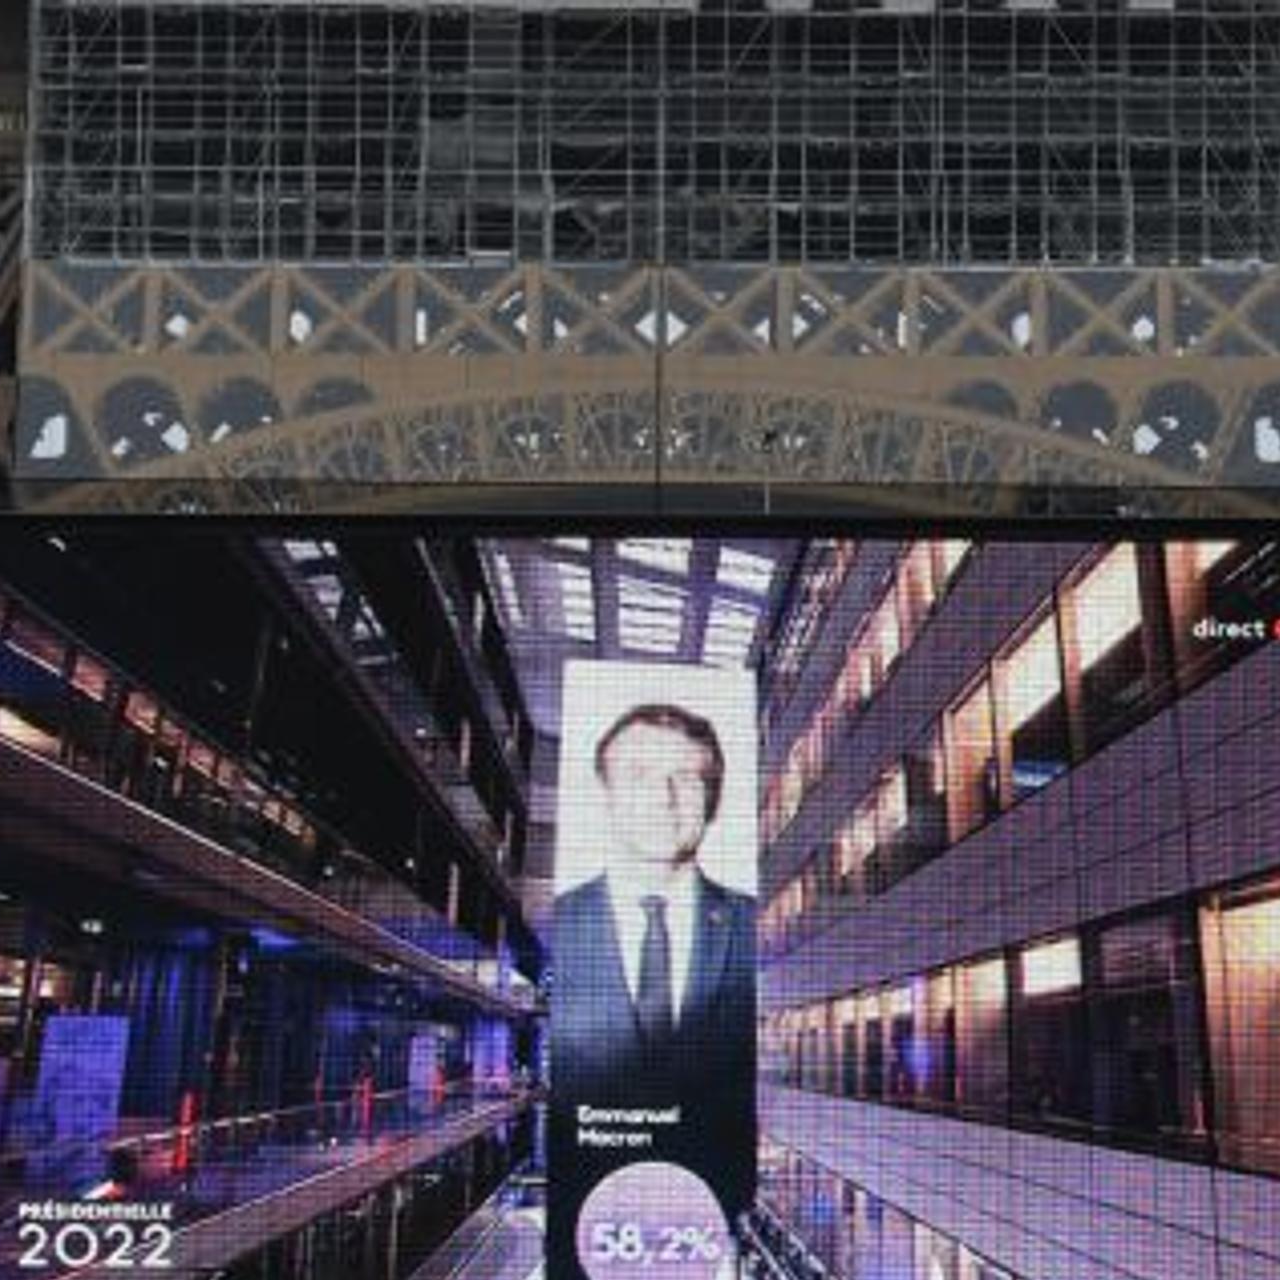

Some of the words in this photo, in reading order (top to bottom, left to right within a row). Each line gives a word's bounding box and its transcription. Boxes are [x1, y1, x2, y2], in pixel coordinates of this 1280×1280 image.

[1192, 617, 1266, 639] direct
[576, 1104, 681, 1124] Emmanuel
[577, 1128, 653, 1147] Macron
[19, 1199, 173, 1220] PRÉSIDENTIELLE
[18, 1222, 172, 1267] 2022
[591, 1221, 722, 1267] 58,2%
